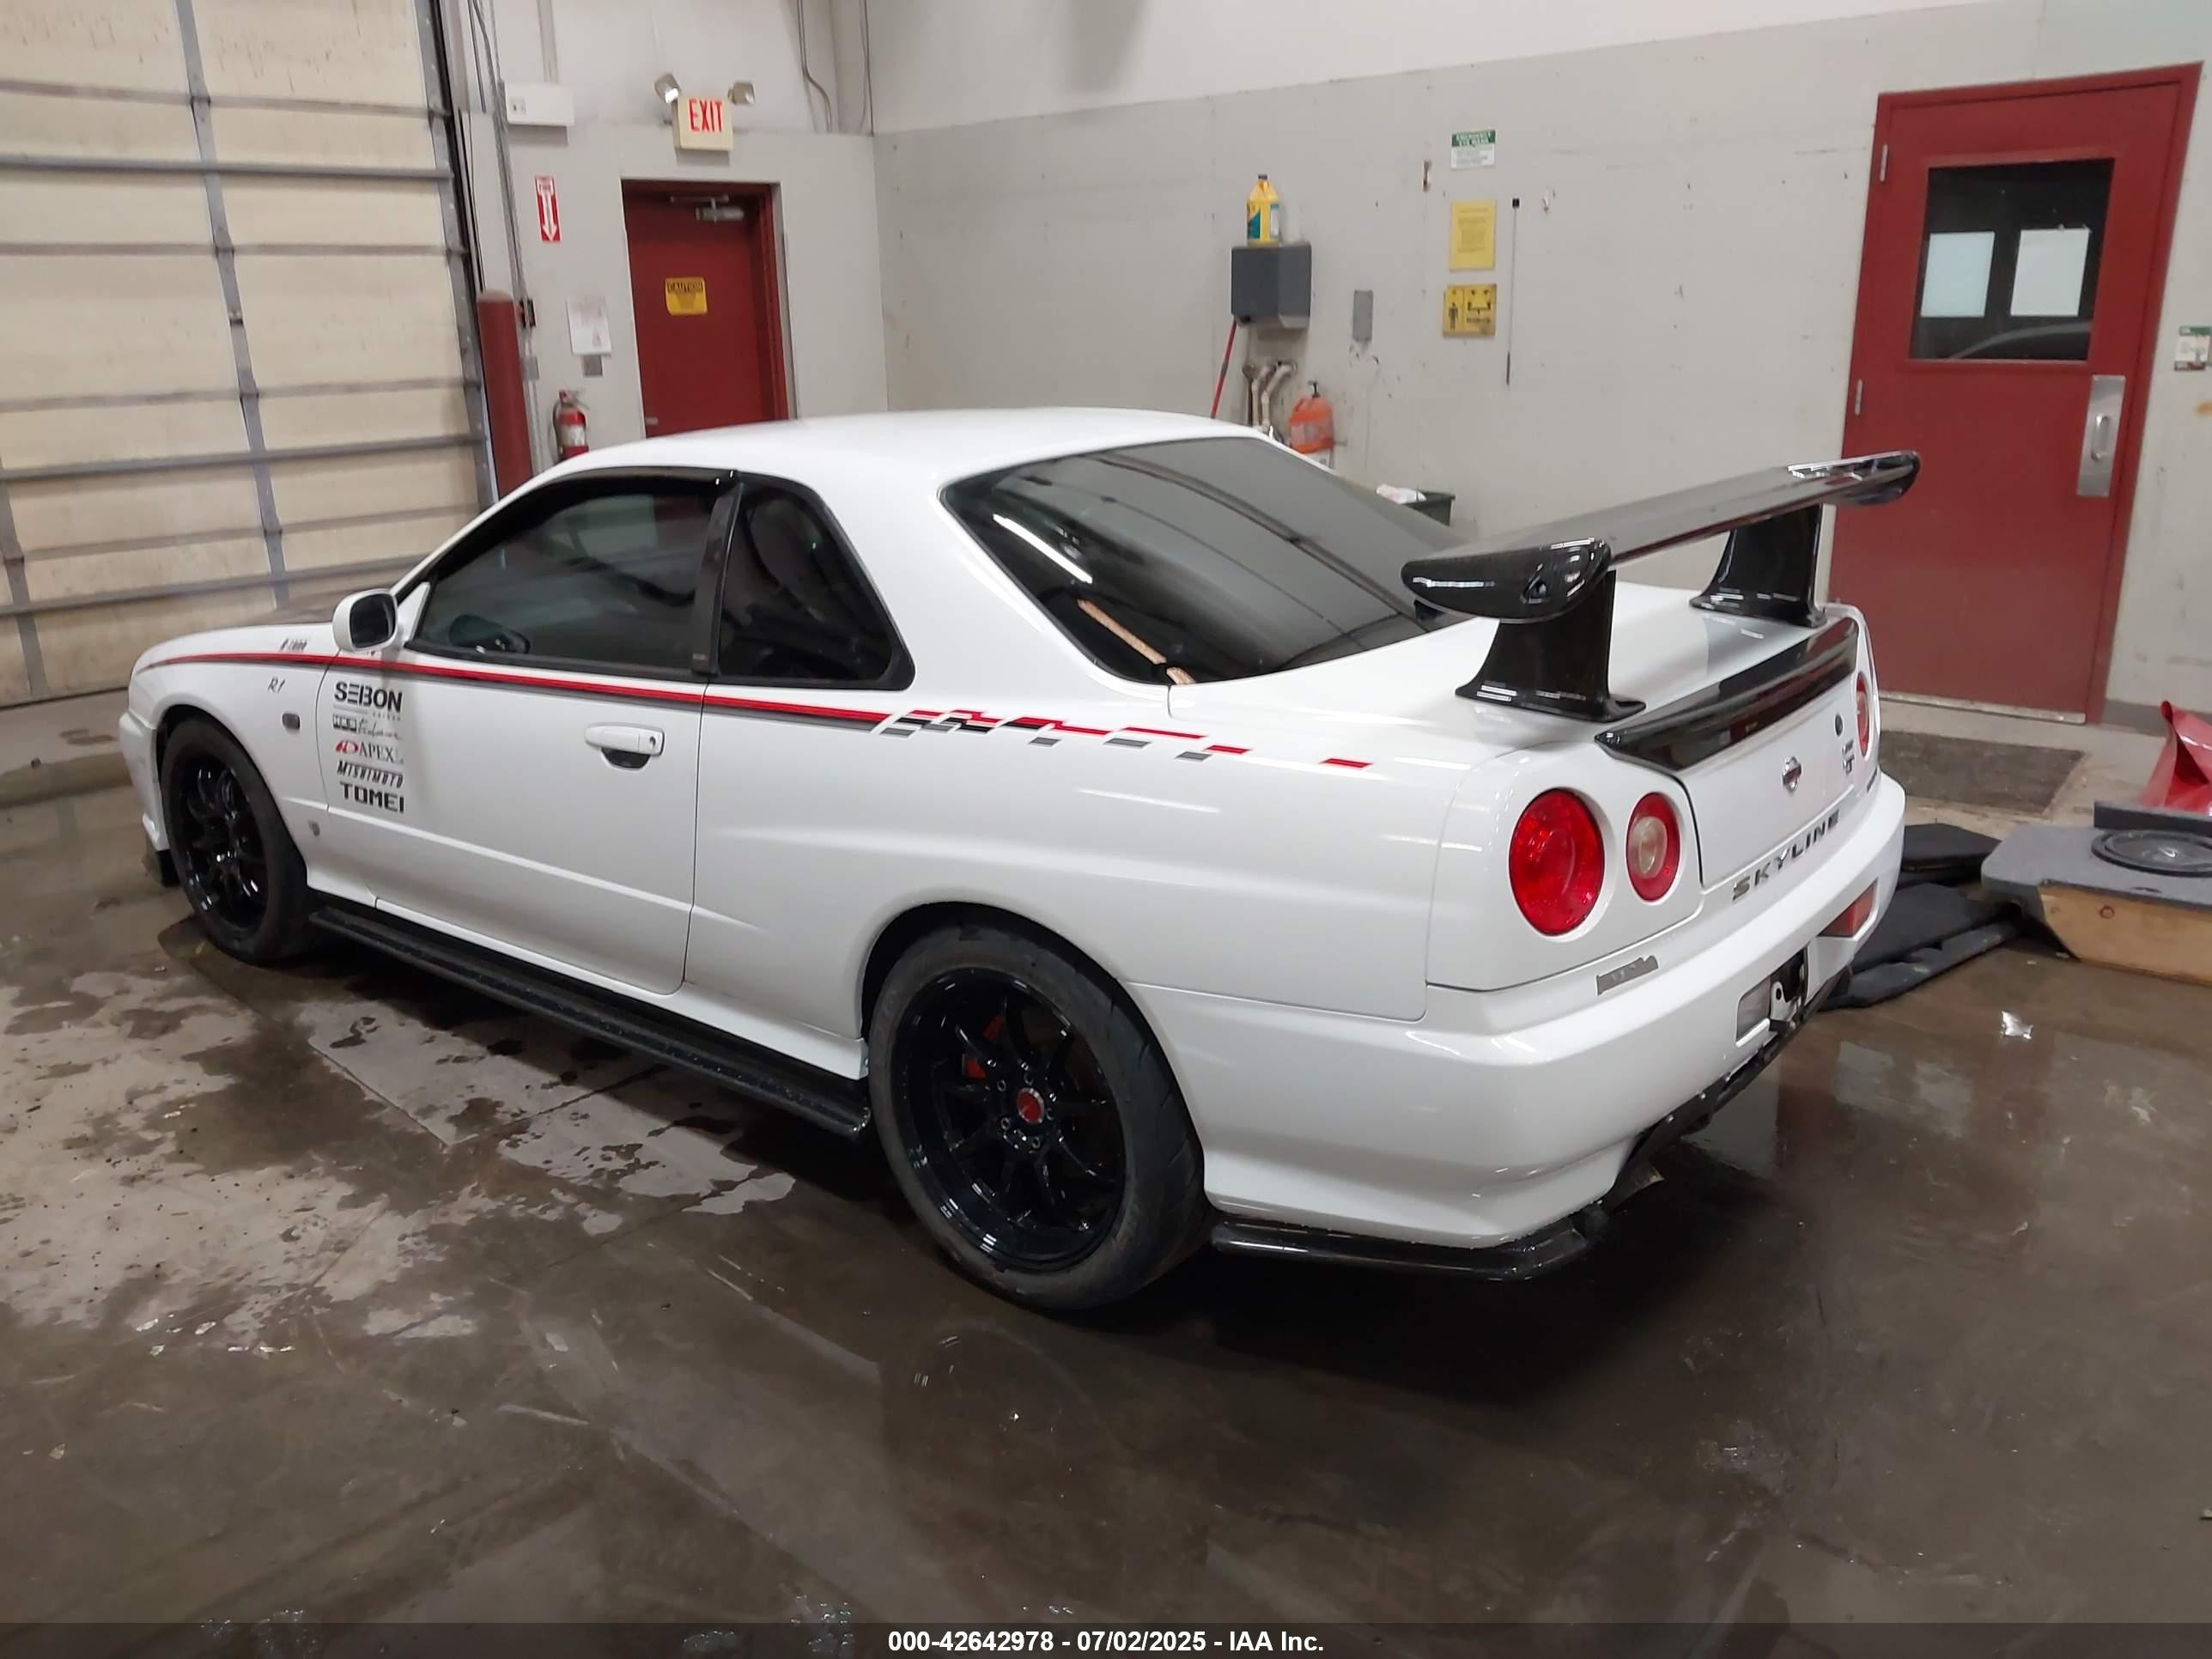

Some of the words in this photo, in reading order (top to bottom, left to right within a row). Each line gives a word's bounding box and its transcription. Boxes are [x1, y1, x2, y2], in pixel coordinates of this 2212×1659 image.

[689, 99, 722, 132] EXIT
[334, 681, 403, 712] SEBON
[337, 760, 404, 789] MISHIMOTO
[340, 781, 404, 813] TOMEI
[1732, 808, 1839, 901] SKYLINE
